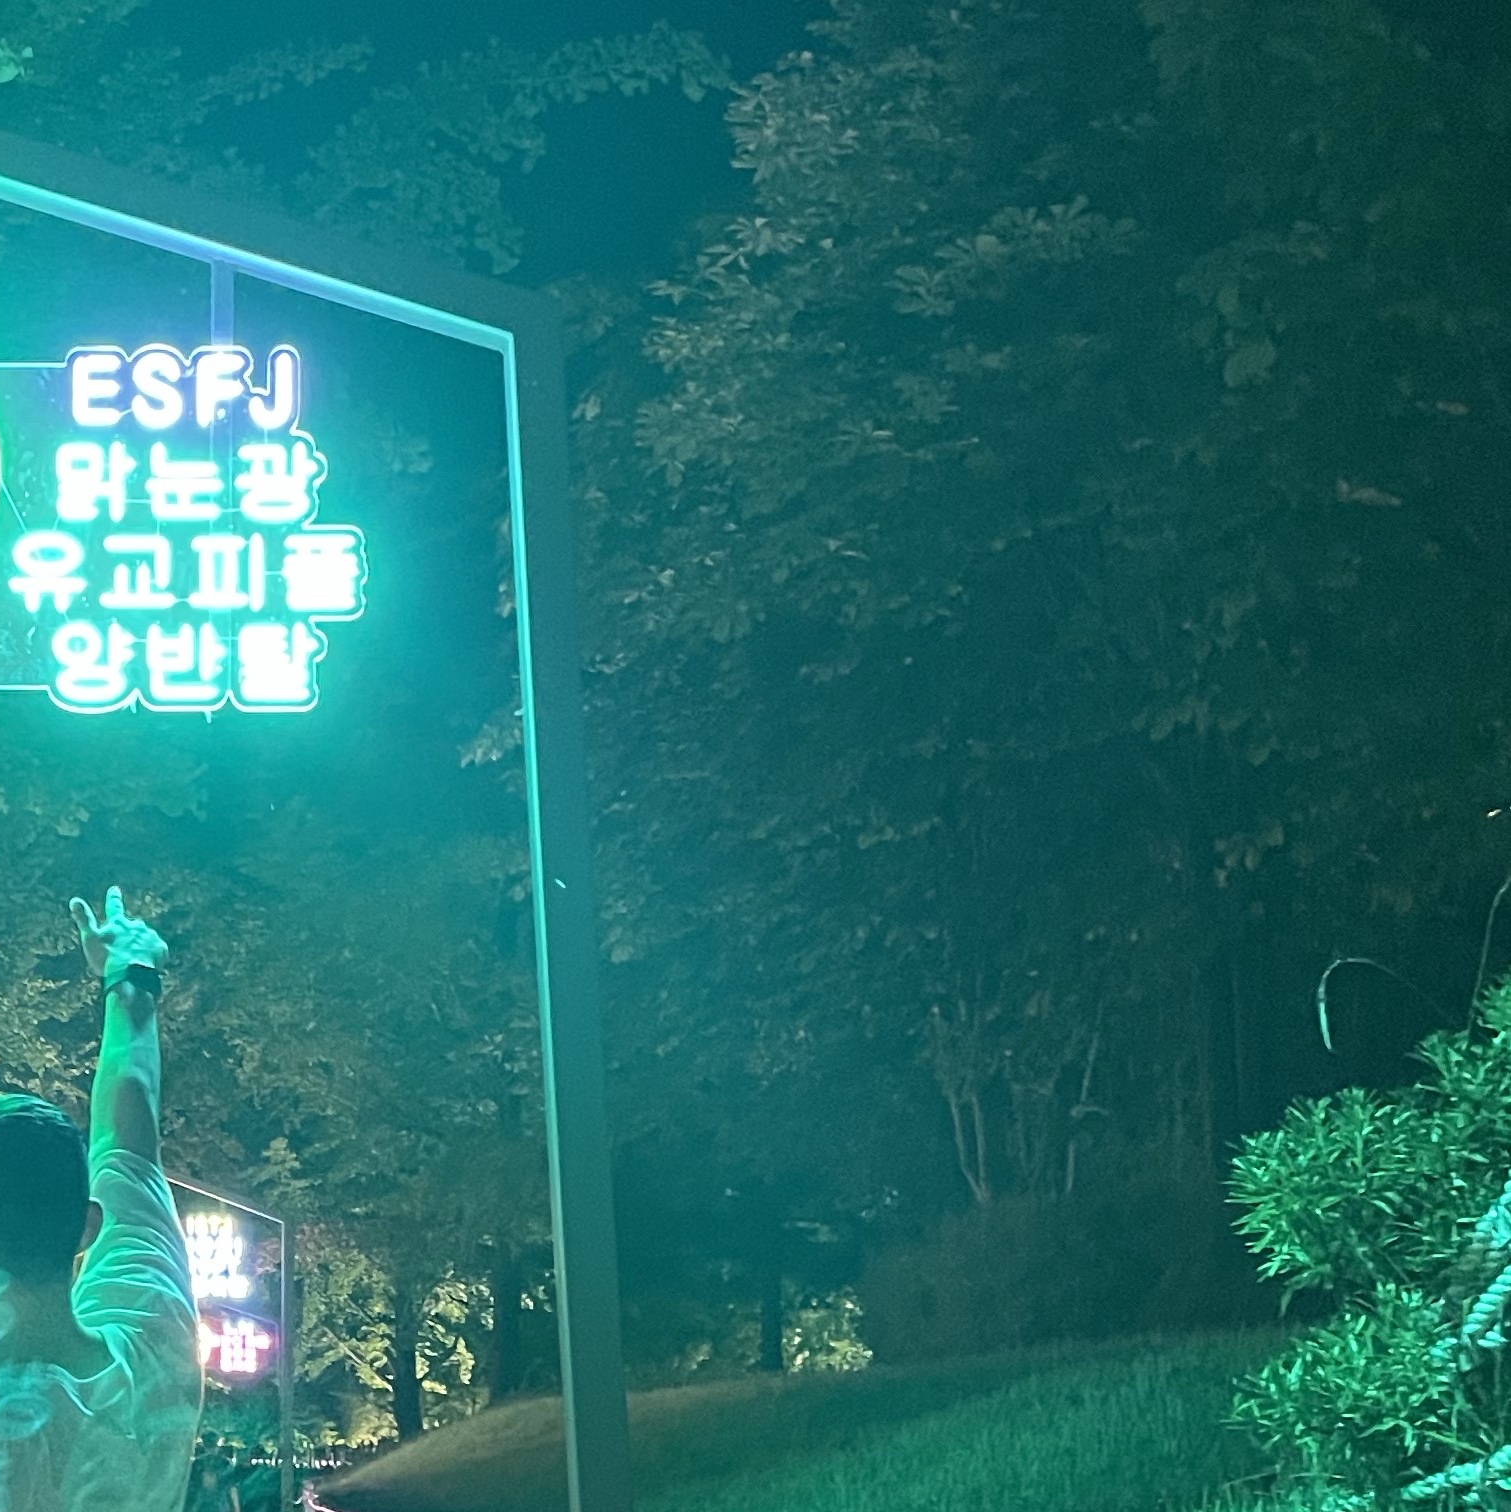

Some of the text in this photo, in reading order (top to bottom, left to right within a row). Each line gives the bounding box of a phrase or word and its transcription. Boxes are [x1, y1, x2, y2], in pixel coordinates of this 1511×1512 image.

[72, 352, 294, 429] ESFJ
[56, 441, 319, 522] 맑눈광
[8, 532, 359, 613] 유교피플
[52, 620, 319, 702] 양반탈
